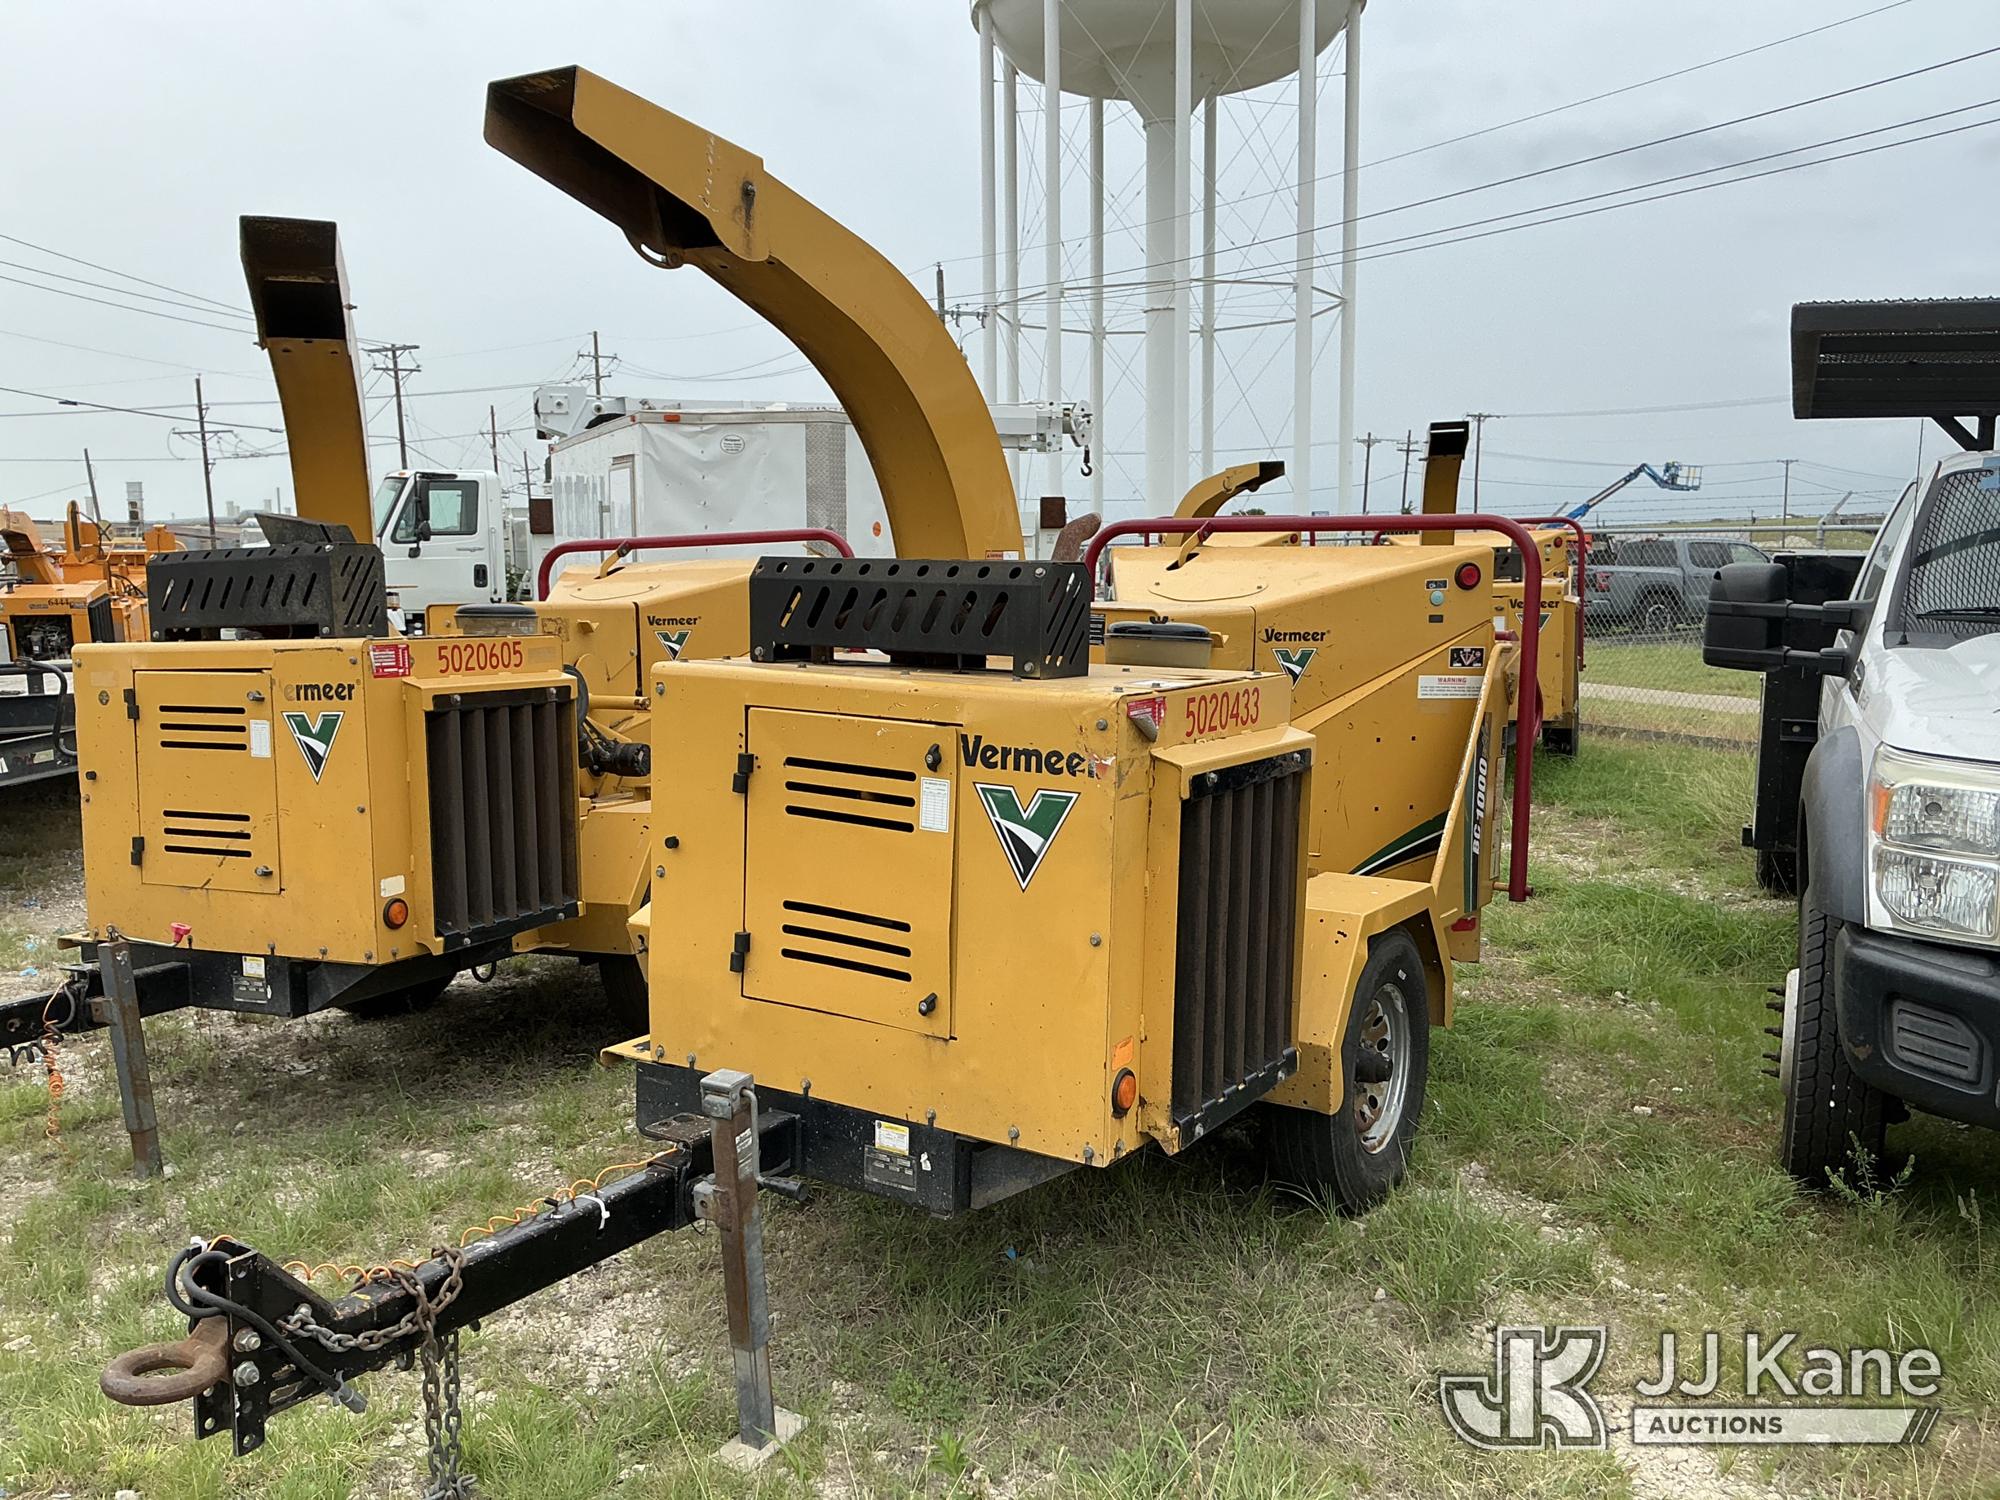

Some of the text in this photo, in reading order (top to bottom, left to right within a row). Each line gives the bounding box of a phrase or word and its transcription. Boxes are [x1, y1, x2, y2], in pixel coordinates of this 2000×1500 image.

[1509, 599, 1560, 609] Veeer
[647, 616, 698, 626] Vermeer
[1264, 628, 1326, 642] Vermeer
[438, 640, 523, 674] 5020605
[1185, 687, 1260, 739] 5020433
